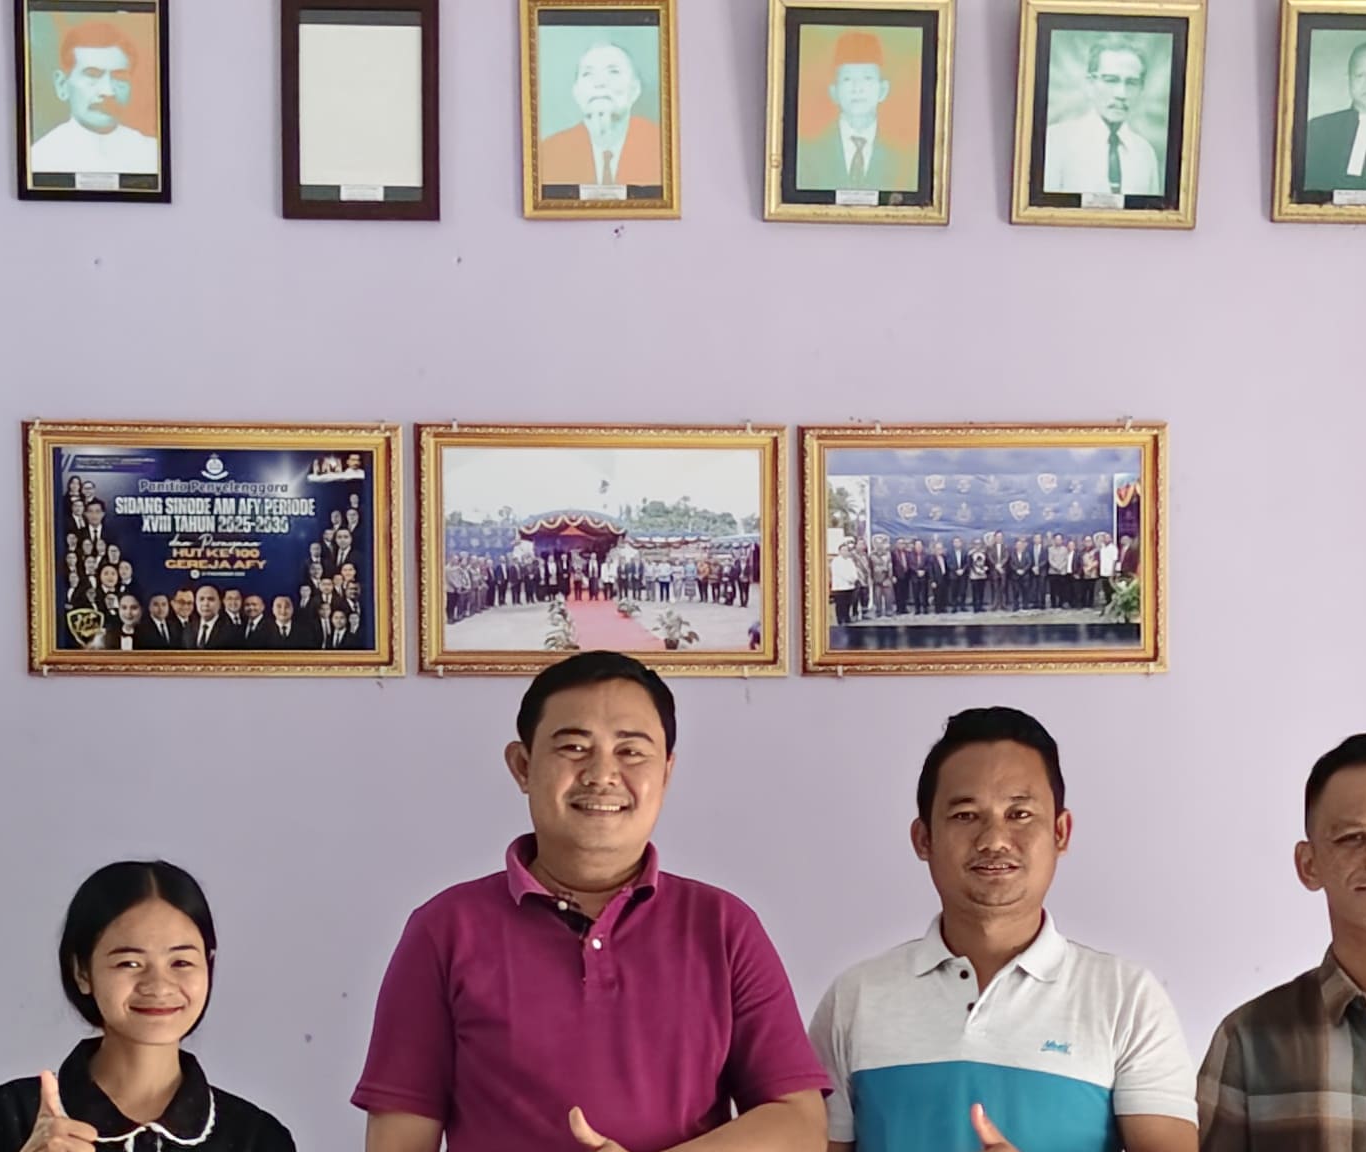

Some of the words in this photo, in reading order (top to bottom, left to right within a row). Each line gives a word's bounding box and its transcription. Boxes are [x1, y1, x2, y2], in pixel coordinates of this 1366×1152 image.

[115, 497, 163, 514] SIDANG
[165, 497, 212, 515] SINODE
[213, 498, 235, 515] AM
[238, 498, 262, 515] AFY
[264, 498, 315, 516] PERIODE
[142, 515, 172, 533] XVIII
[174, 515, 215, 533] TAHUN
[217, 516, 290, 533] 2025-2030
[172, 548, 203, 558] HUT
[165, 559, 232, 569] GEREJA
[233, 560, 266, 569] AFY
